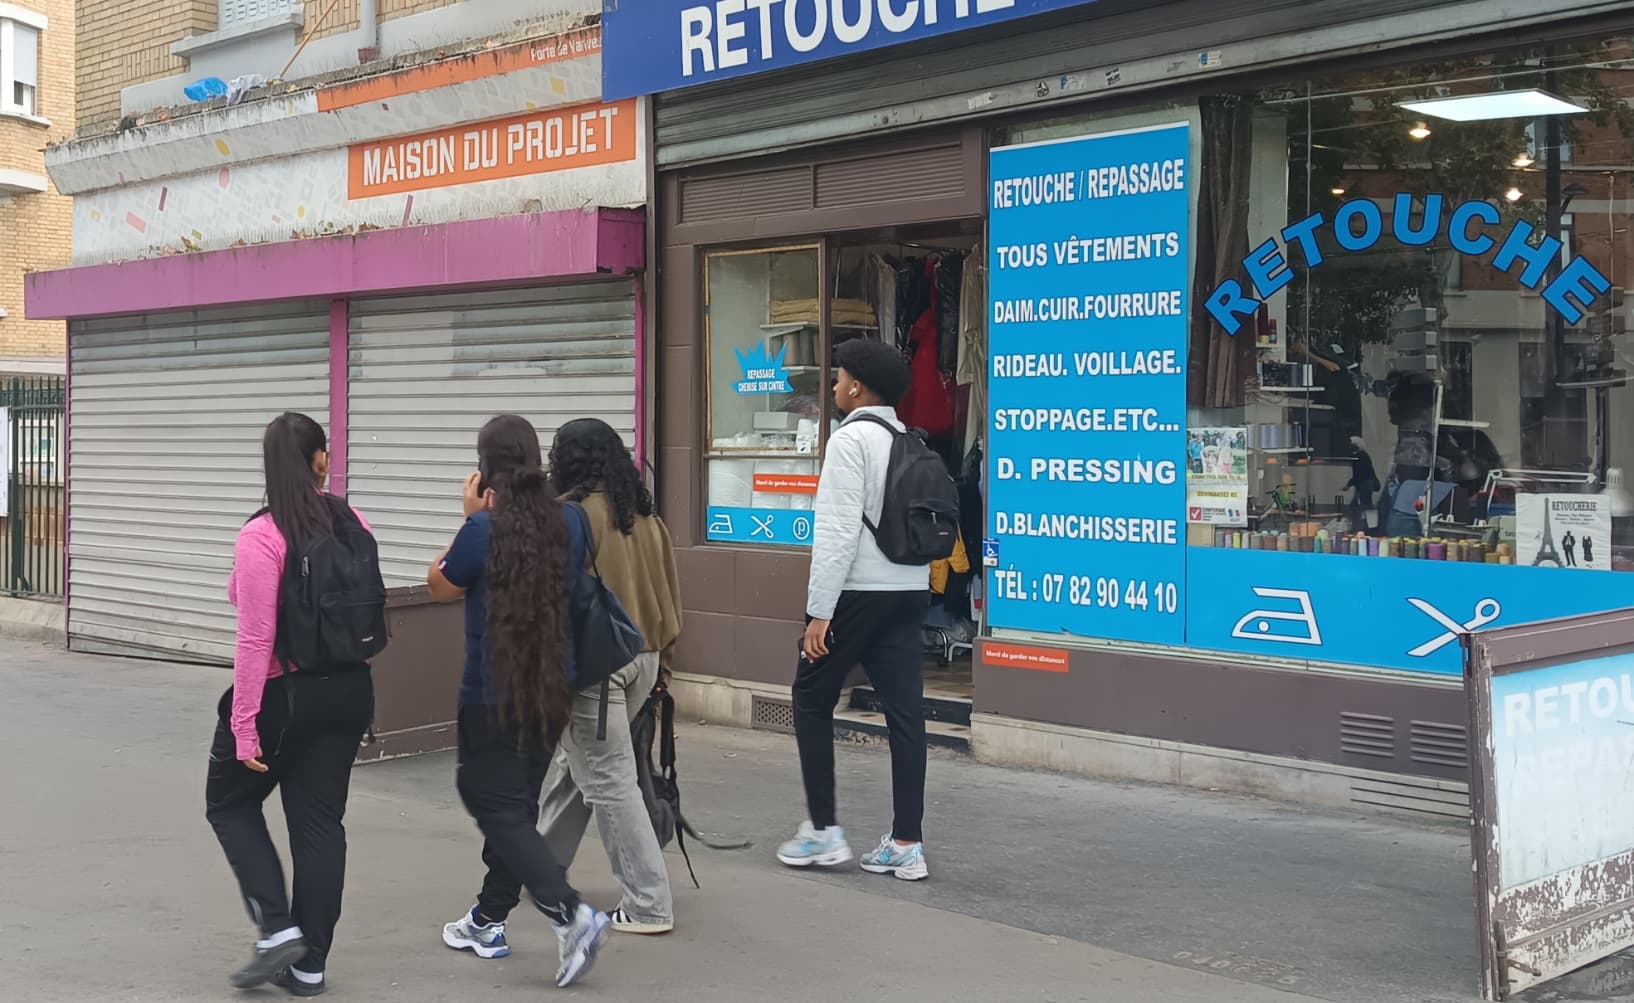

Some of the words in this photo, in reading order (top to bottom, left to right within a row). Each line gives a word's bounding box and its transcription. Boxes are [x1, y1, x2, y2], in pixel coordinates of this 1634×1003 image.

[531, 46, 556, 62] Porte
[558, 41, 568, 57] de
[681, 0, 1015, 77] RETOU
[363, 136, 455, 187] MAISON
[463, 128, 498, 171] DU
[508, 107, 618, 165] PROJET
[993, 171, 1075, 209] RETOUCHE
[1088, 158, 1184, 199] REPASSAGE
[997, 243, 1048, 269] TOUS
[1053, 232, 1180, 265] VÊTEMENTS
[1203, 192, 1612, 336] RETOUCHE
[993, 353, 1068, 378] RIDEAU.
[1073, 350, 1181, 376] VOILLAGE.
[994, 408, 1180, 432] STOPPAGE.ETC...
[997, 458, 1021, 480] D.
[1031, 458, 1176, 484] PRESSING
[1552, 501, 1597, 511] RETOUCHERIE
[995, 511, 1177, 545] D.BLANCHISSERIE
[1042, 573, 1064, 603] 07
[1069, 575, 1091, 606] 82
[1096, 578, 1119, 608] 90
[1124, 580, 1148, 611] 44
[1154, 582, 1177, 614] 10
